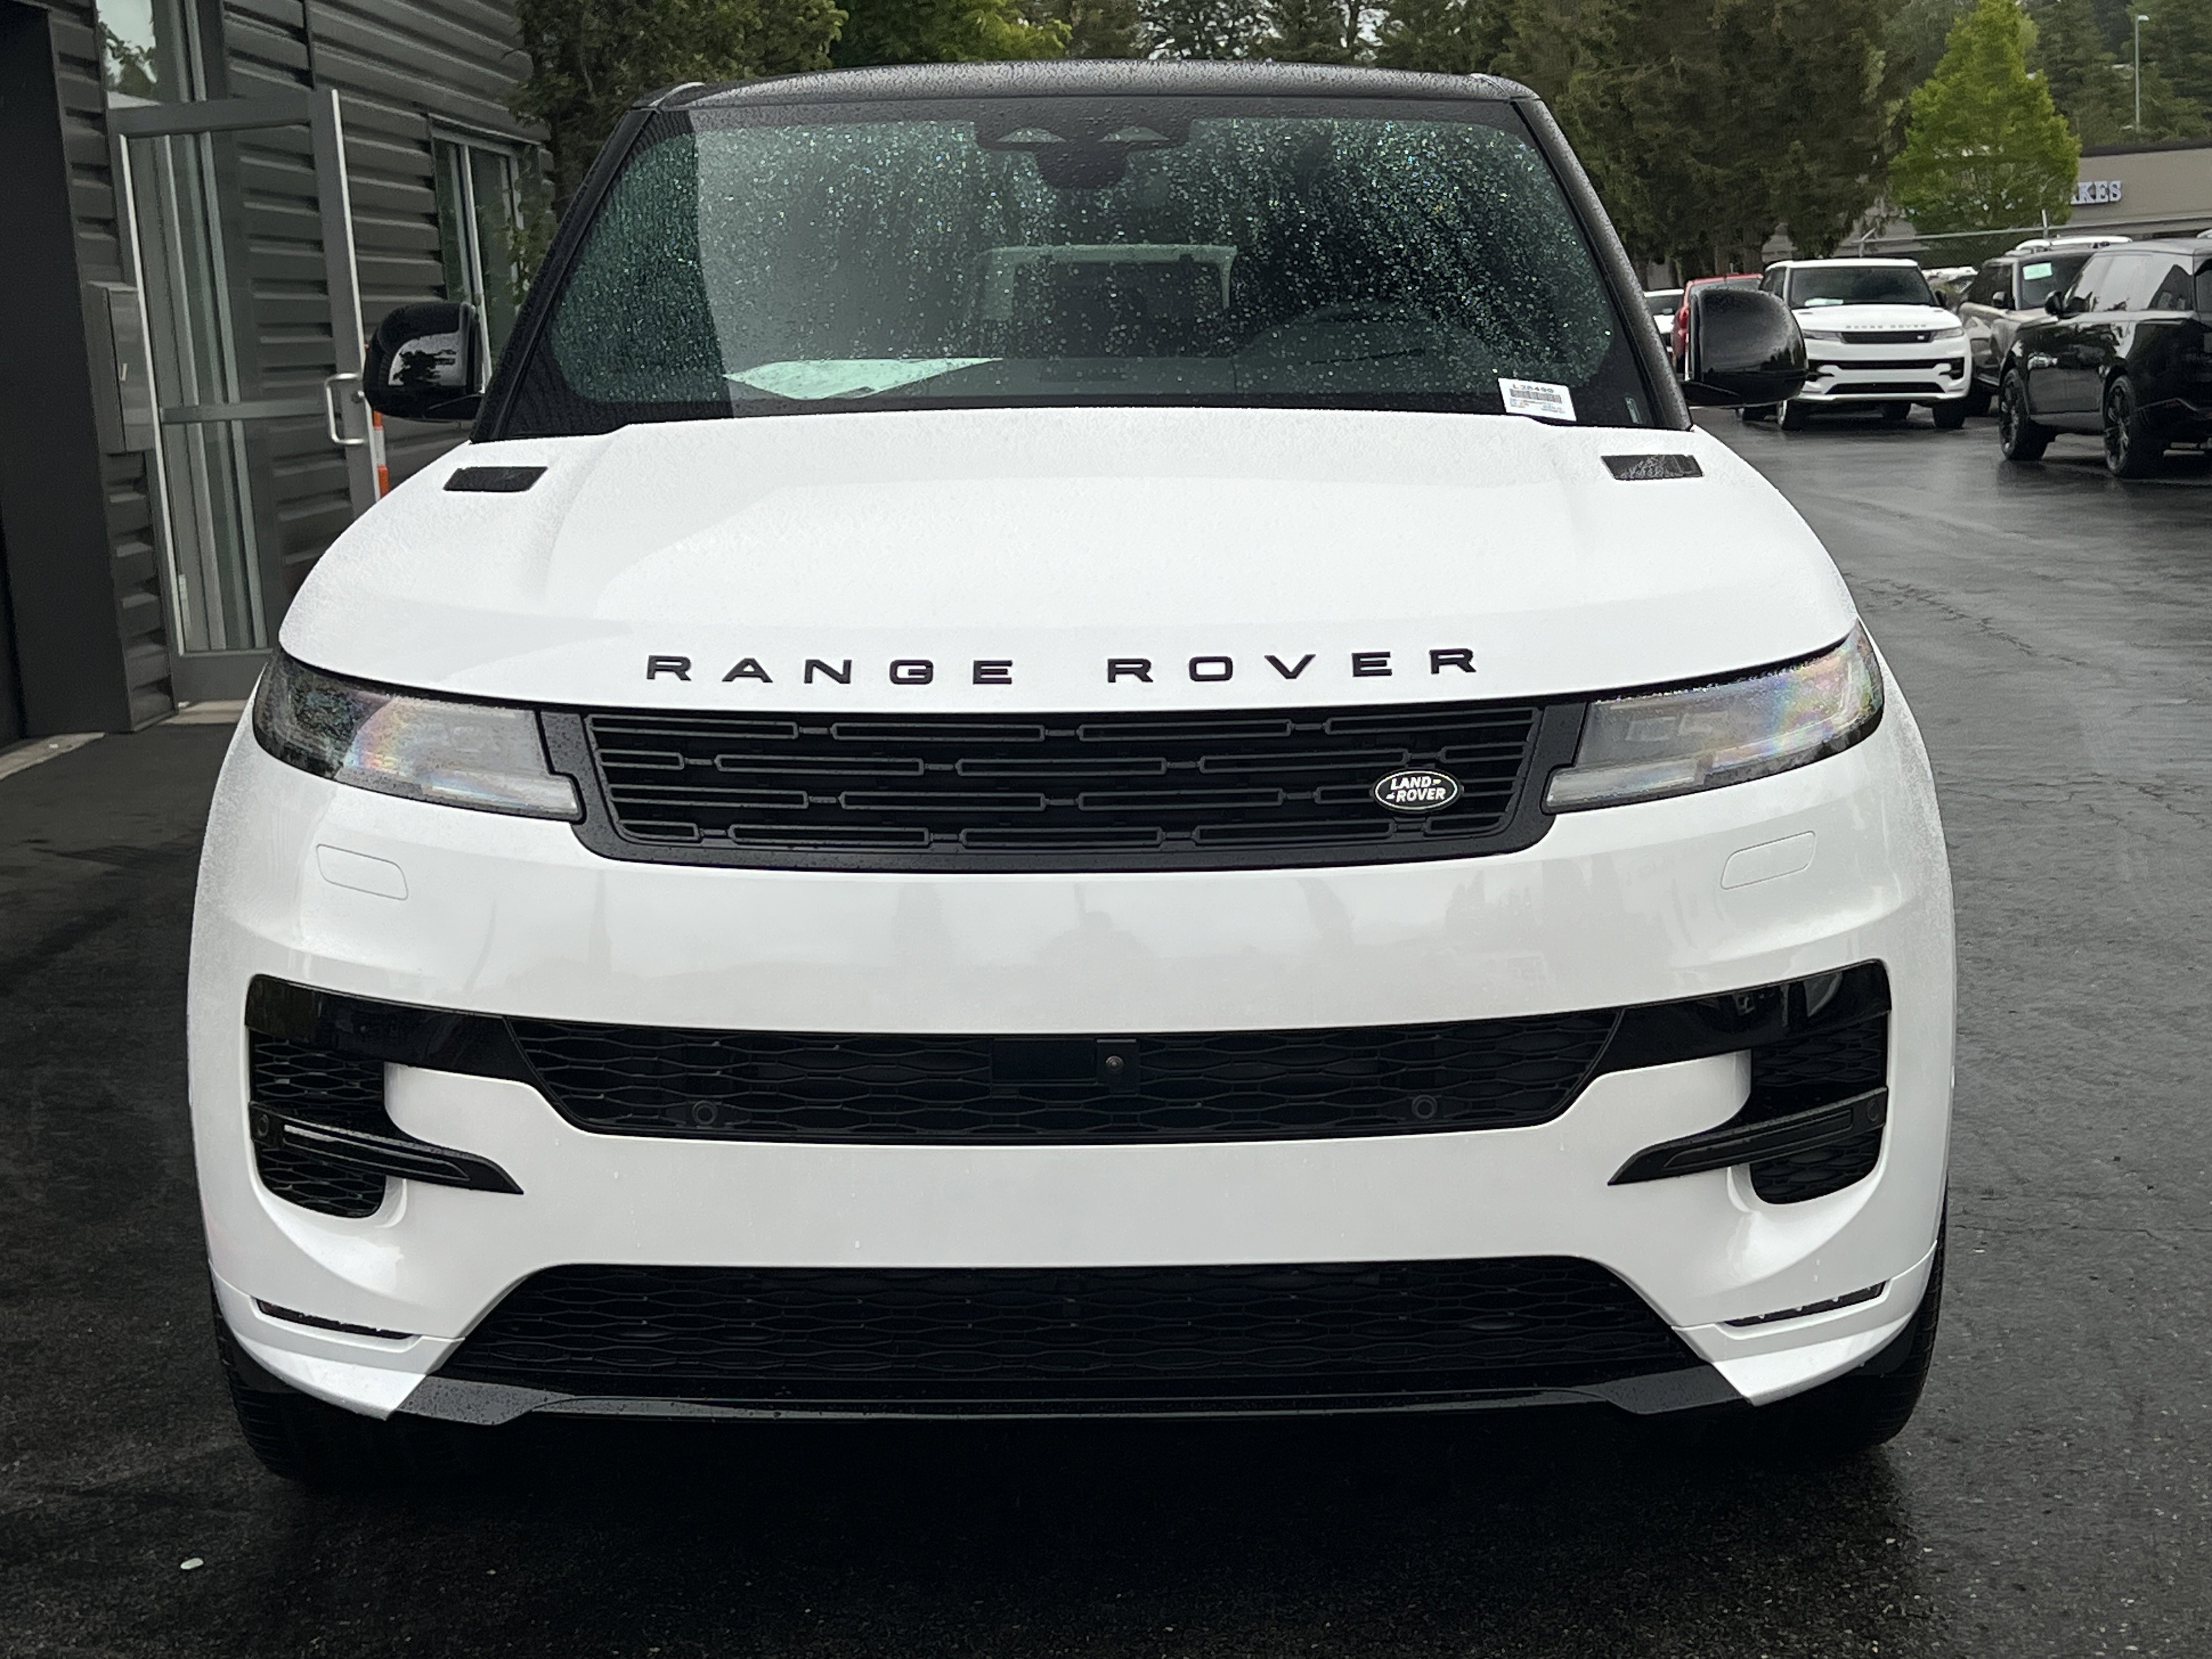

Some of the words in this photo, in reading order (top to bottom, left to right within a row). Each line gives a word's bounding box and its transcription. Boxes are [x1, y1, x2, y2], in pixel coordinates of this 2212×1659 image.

[2070, 180, 2121, 204] KES
[646, 656, 1013, 685] RANGE
[1108, 648, 1476, 683] ROVER
[1391, 776, 1431, 790] LAND
[1396, 787, 1446, 803] ROVER
